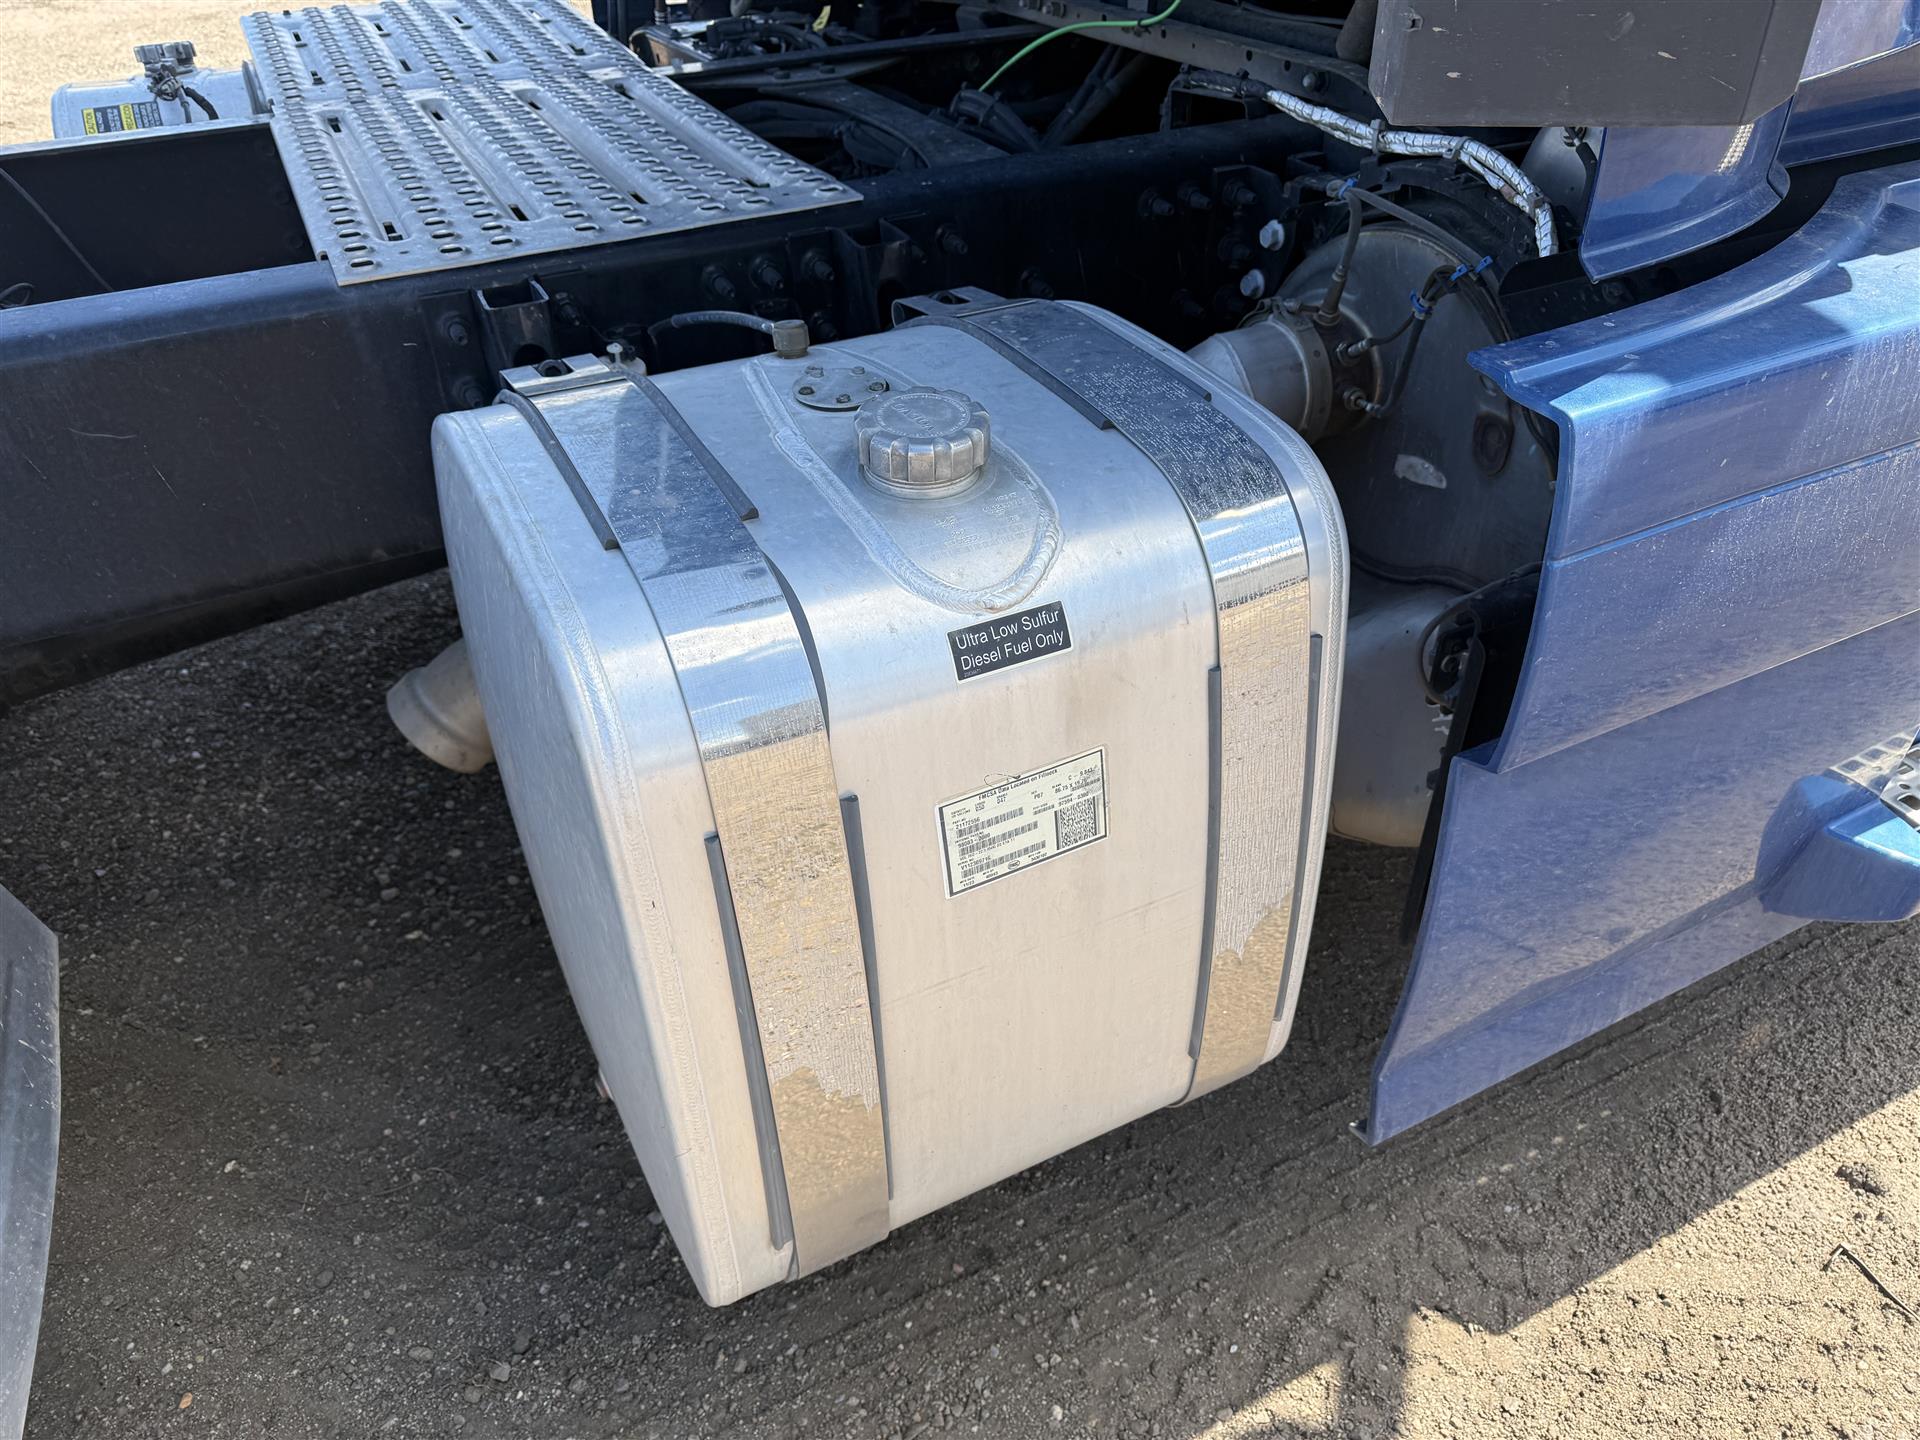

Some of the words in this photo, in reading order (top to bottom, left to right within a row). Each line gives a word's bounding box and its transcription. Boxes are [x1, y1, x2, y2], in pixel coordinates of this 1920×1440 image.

[955, 632, 988, 650] Ultra
[990, 622, 1018, 640] Low
[1021, 610, 1059, 631] Sulfur
[960, 646, 1001, 670] Diesel
[1004, 637, 1033, 658] Fuel
[1035, 630, 1064, 648] Only
[979, 790, 996, 801] FMCSA
[1011, 779, 1029, 789] Located
